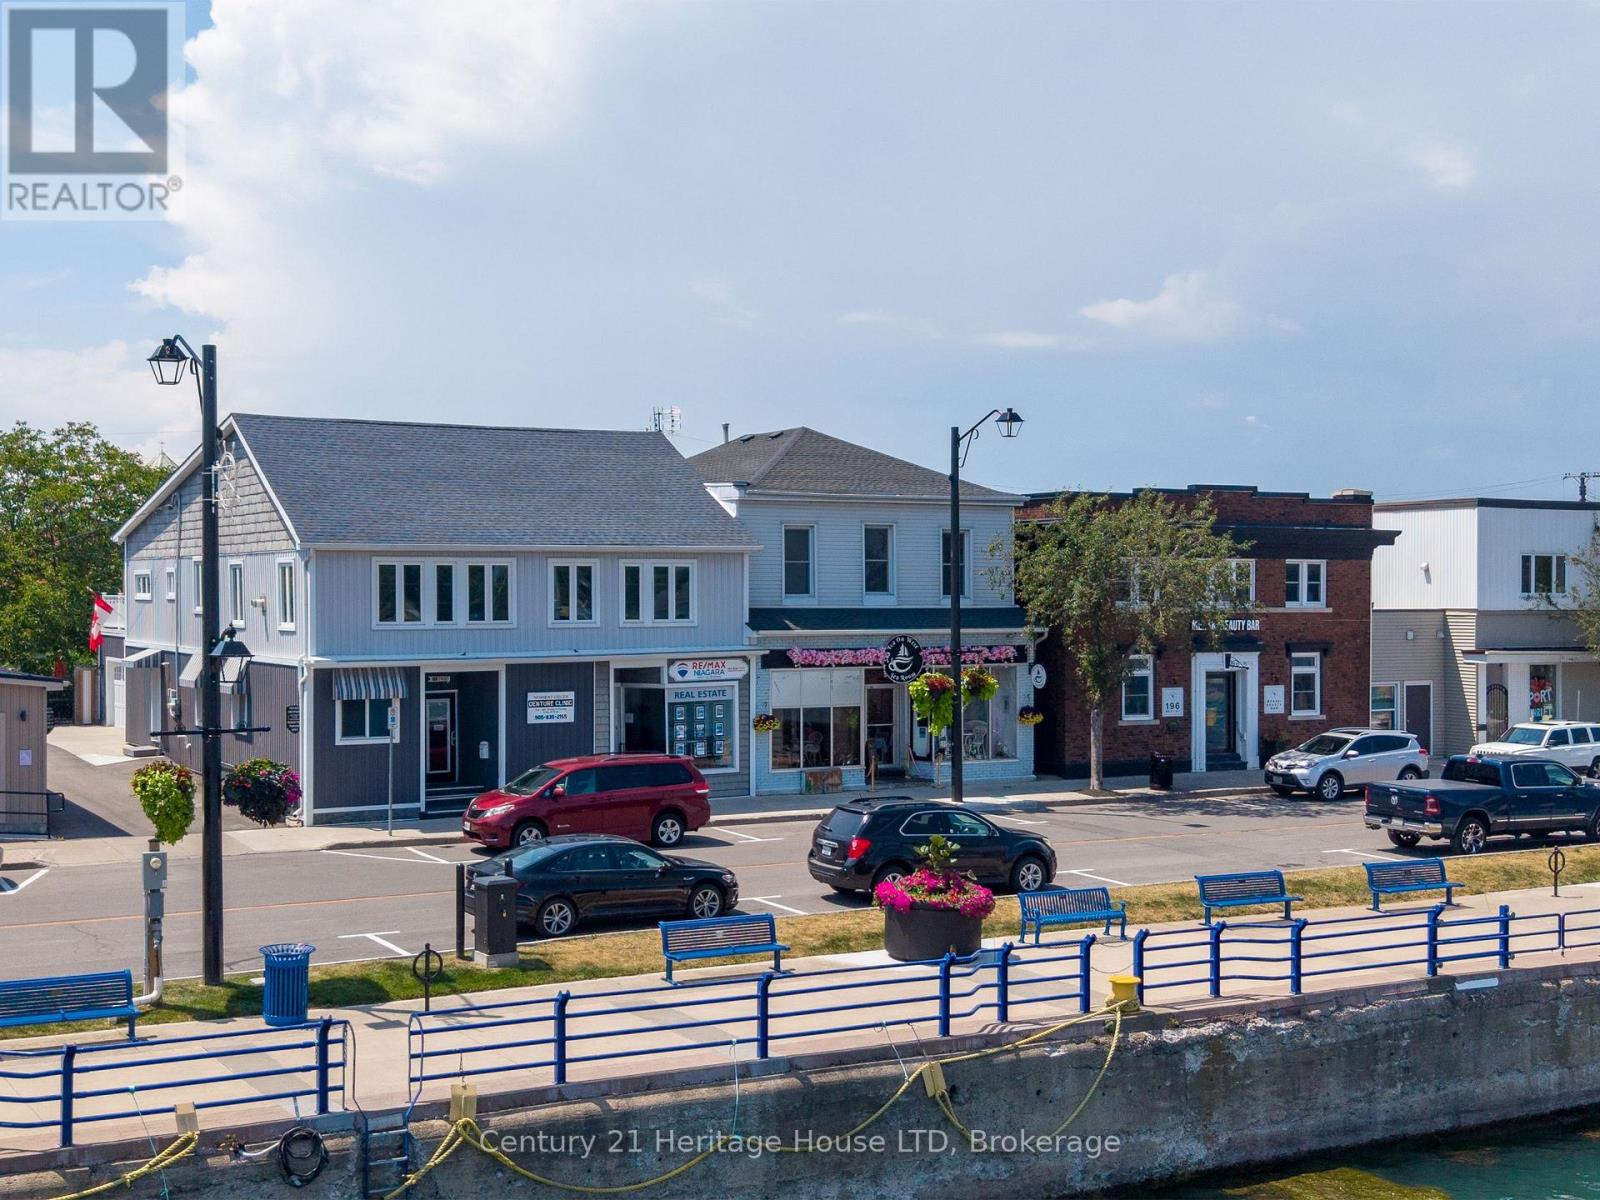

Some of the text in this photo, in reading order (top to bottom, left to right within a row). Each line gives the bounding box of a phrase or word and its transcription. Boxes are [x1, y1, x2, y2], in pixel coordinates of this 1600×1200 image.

[1246, 619, 1260, 631] BAR
[692, 661, 726, 670] RE/MAX
[674, 689, 727, 700] REAL ESTATE
[1165, 702, 1181, 710] 196
